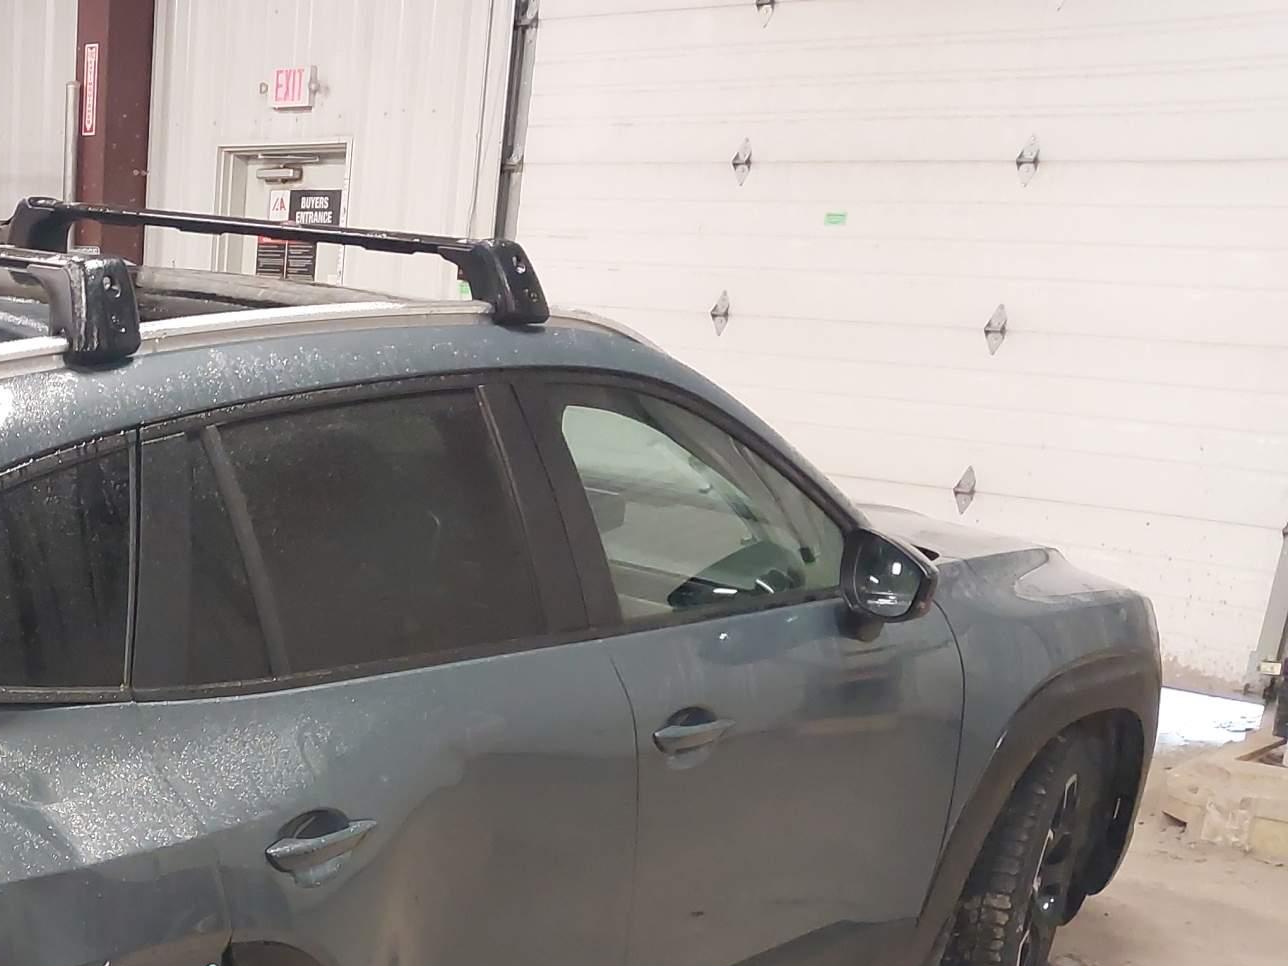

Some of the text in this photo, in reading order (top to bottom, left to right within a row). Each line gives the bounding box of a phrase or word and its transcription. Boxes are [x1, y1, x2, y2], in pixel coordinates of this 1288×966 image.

[275, 69, 304, 101] EXIT
[300, 196, 330, 209] BUYERS
[295, 211, 333, 224] ENTRANCE
